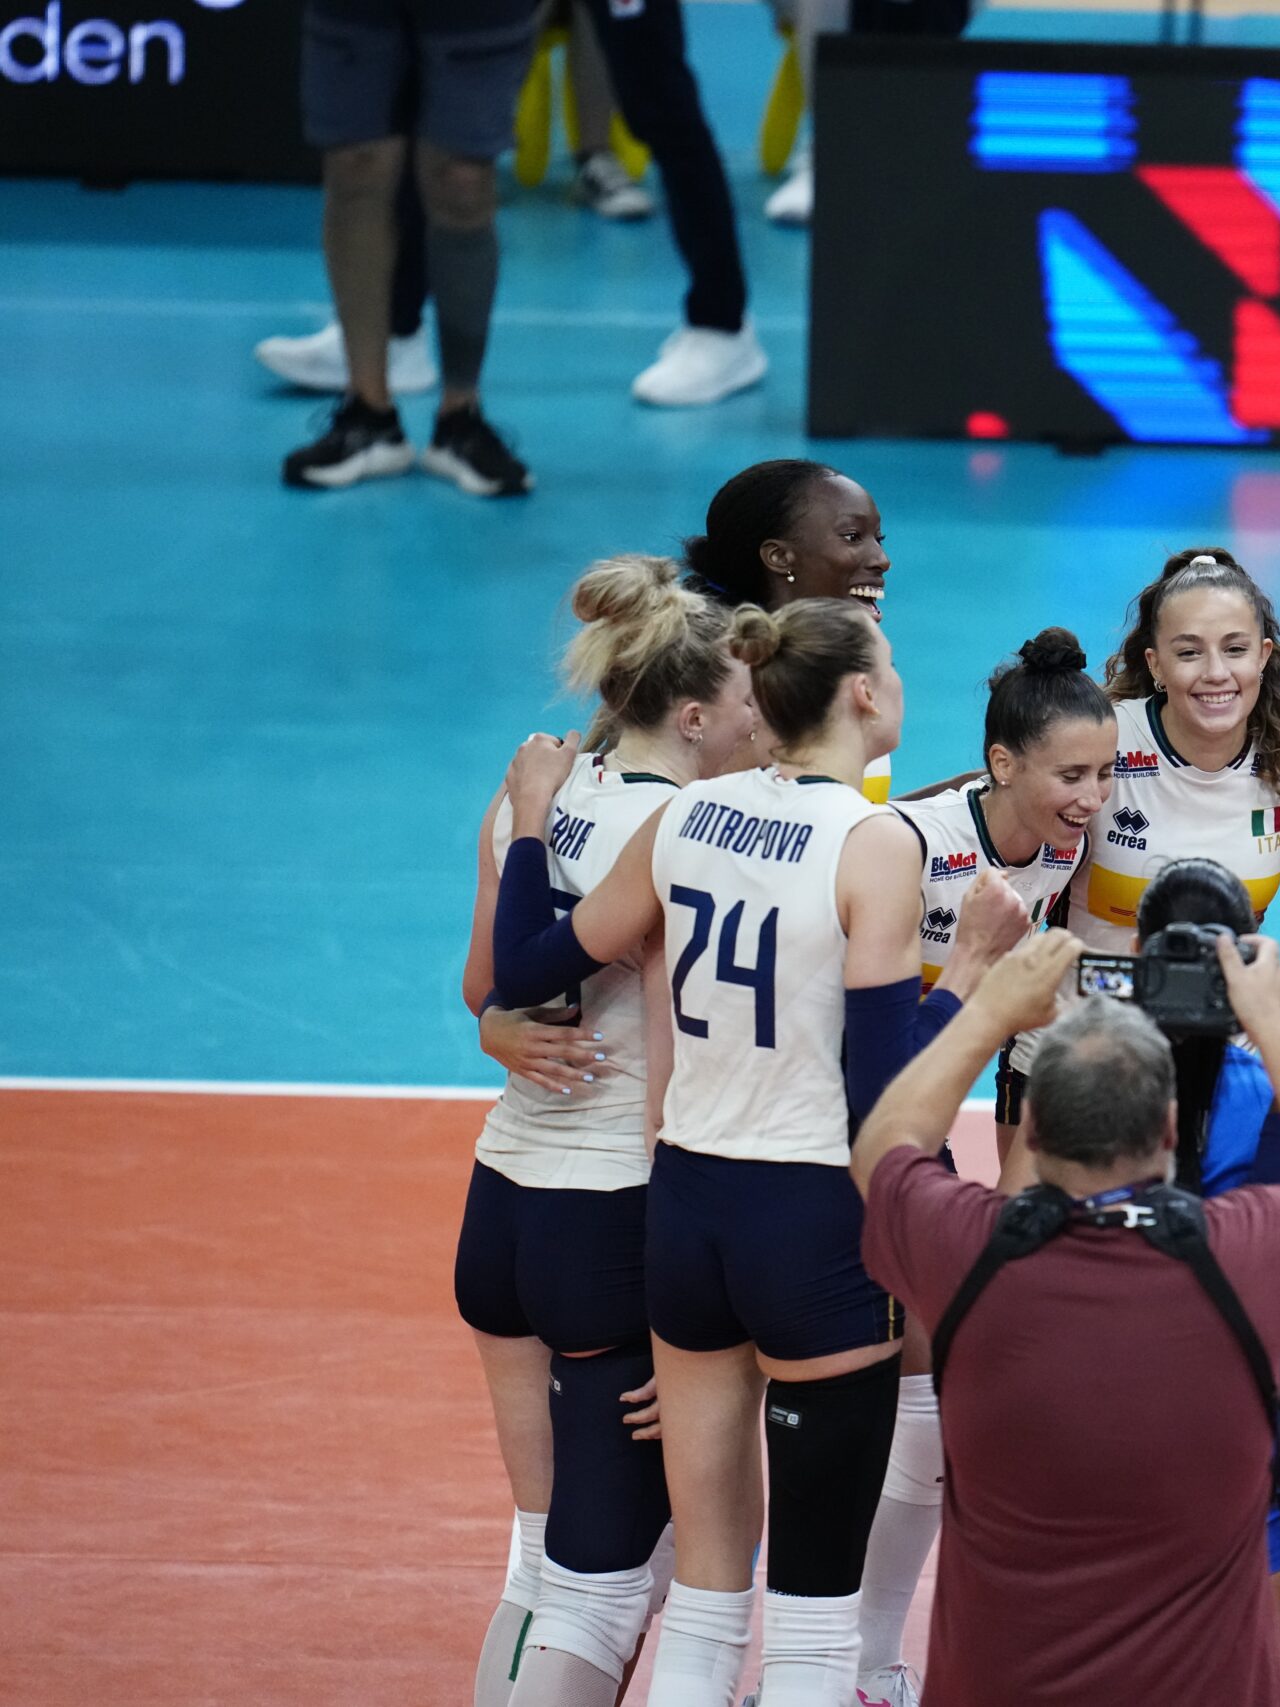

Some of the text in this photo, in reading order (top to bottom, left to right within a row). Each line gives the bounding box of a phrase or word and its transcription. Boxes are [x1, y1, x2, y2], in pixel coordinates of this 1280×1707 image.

[0, 0, 186, 85] den
[1132, 771, 1160, 779] BUILDERS
[678, 799, 813, 863] ANTROPOVA
[1107, 829, 1147, 850] errea
[931, 852, 977, 875] BigMat
[953, 870, 977, 880] BUILDERS
[669, 883, 779, 1049] 24
